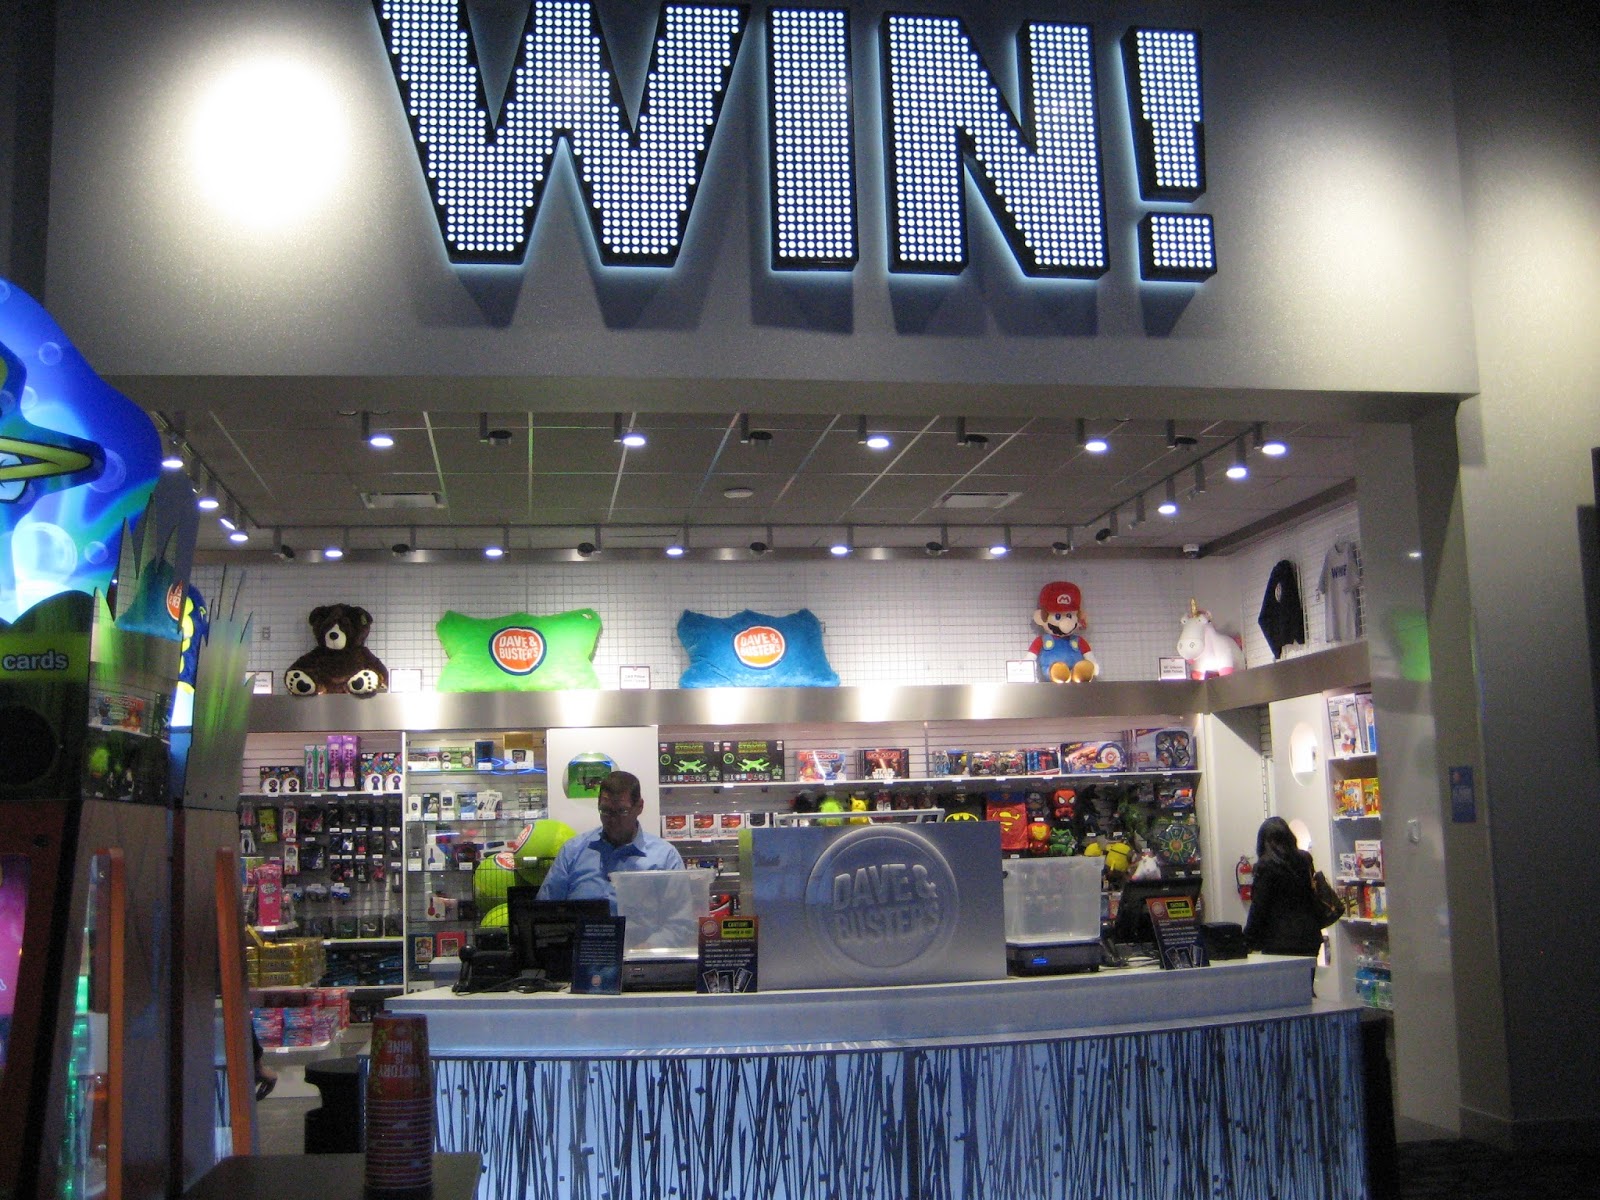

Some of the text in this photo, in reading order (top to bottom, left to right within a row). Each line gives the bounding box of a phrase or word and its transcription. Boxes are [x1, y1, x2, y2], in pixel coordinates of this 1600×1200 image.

[373, 0, 1217, 281] WIN!
[499, 634, 538, 649] DAVE &
[740, 632, 780, 647] DAVE &
[3, 649, 68, 671] cards
[834, 863, 939, 911] DAVE &
[387, 1040, 413, 1054] MINE
[377, 1063, 420, 1079] VICTORY
